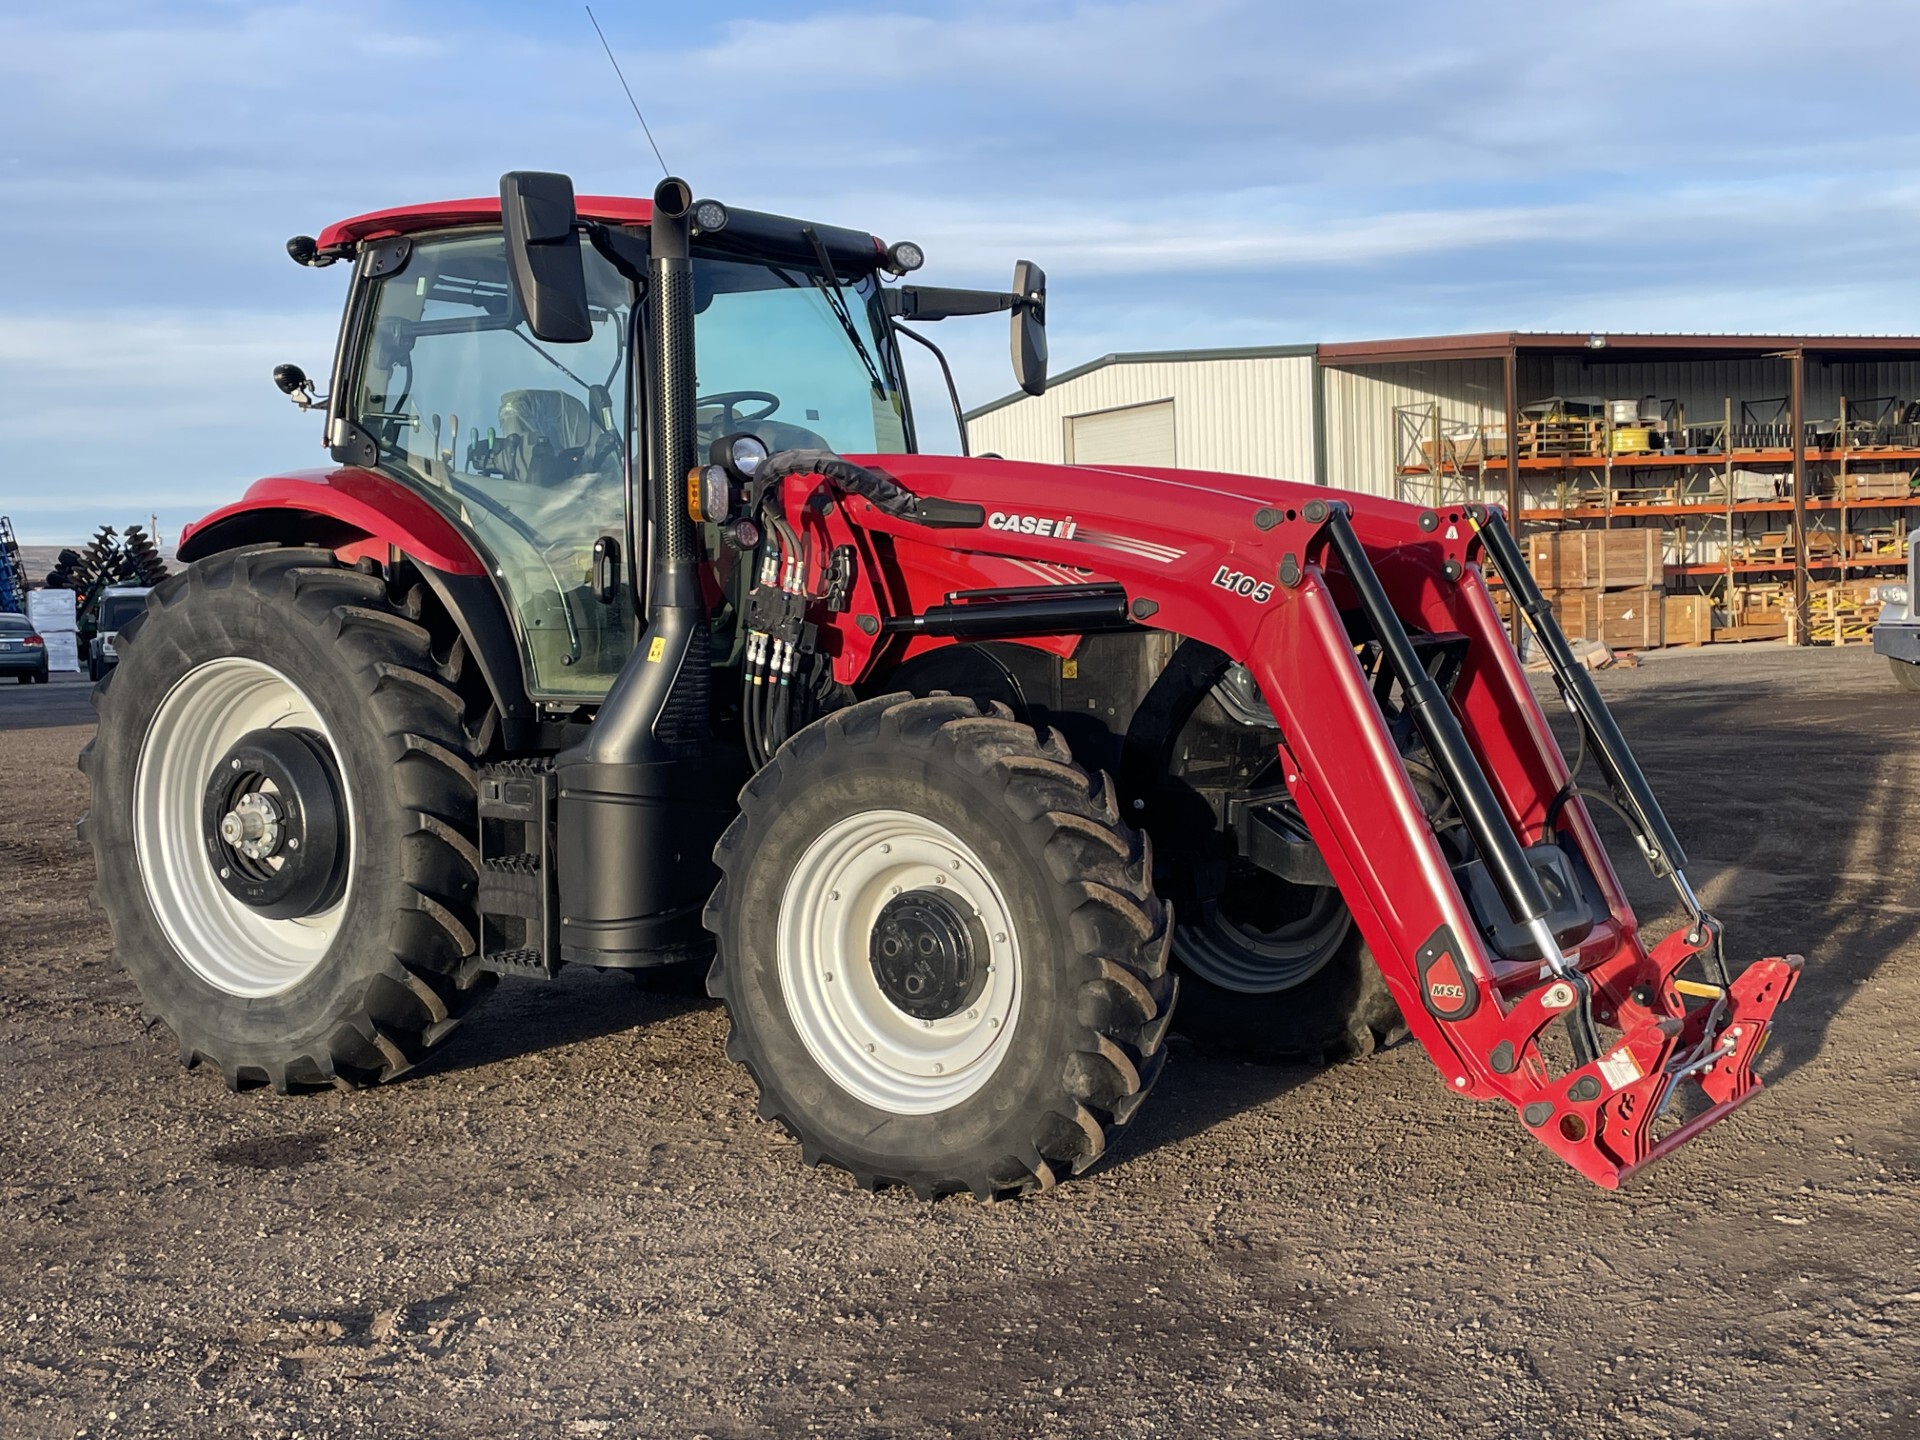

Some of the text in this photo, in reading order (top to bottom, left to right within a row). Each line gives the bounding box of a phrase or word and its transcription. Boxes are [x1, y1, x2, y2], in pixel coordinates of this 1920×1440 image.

[988, 512, 1053, 536] CASE
[1211, 565, 1275, 604] L105
[1431, 984, 1463, 998] MSL
